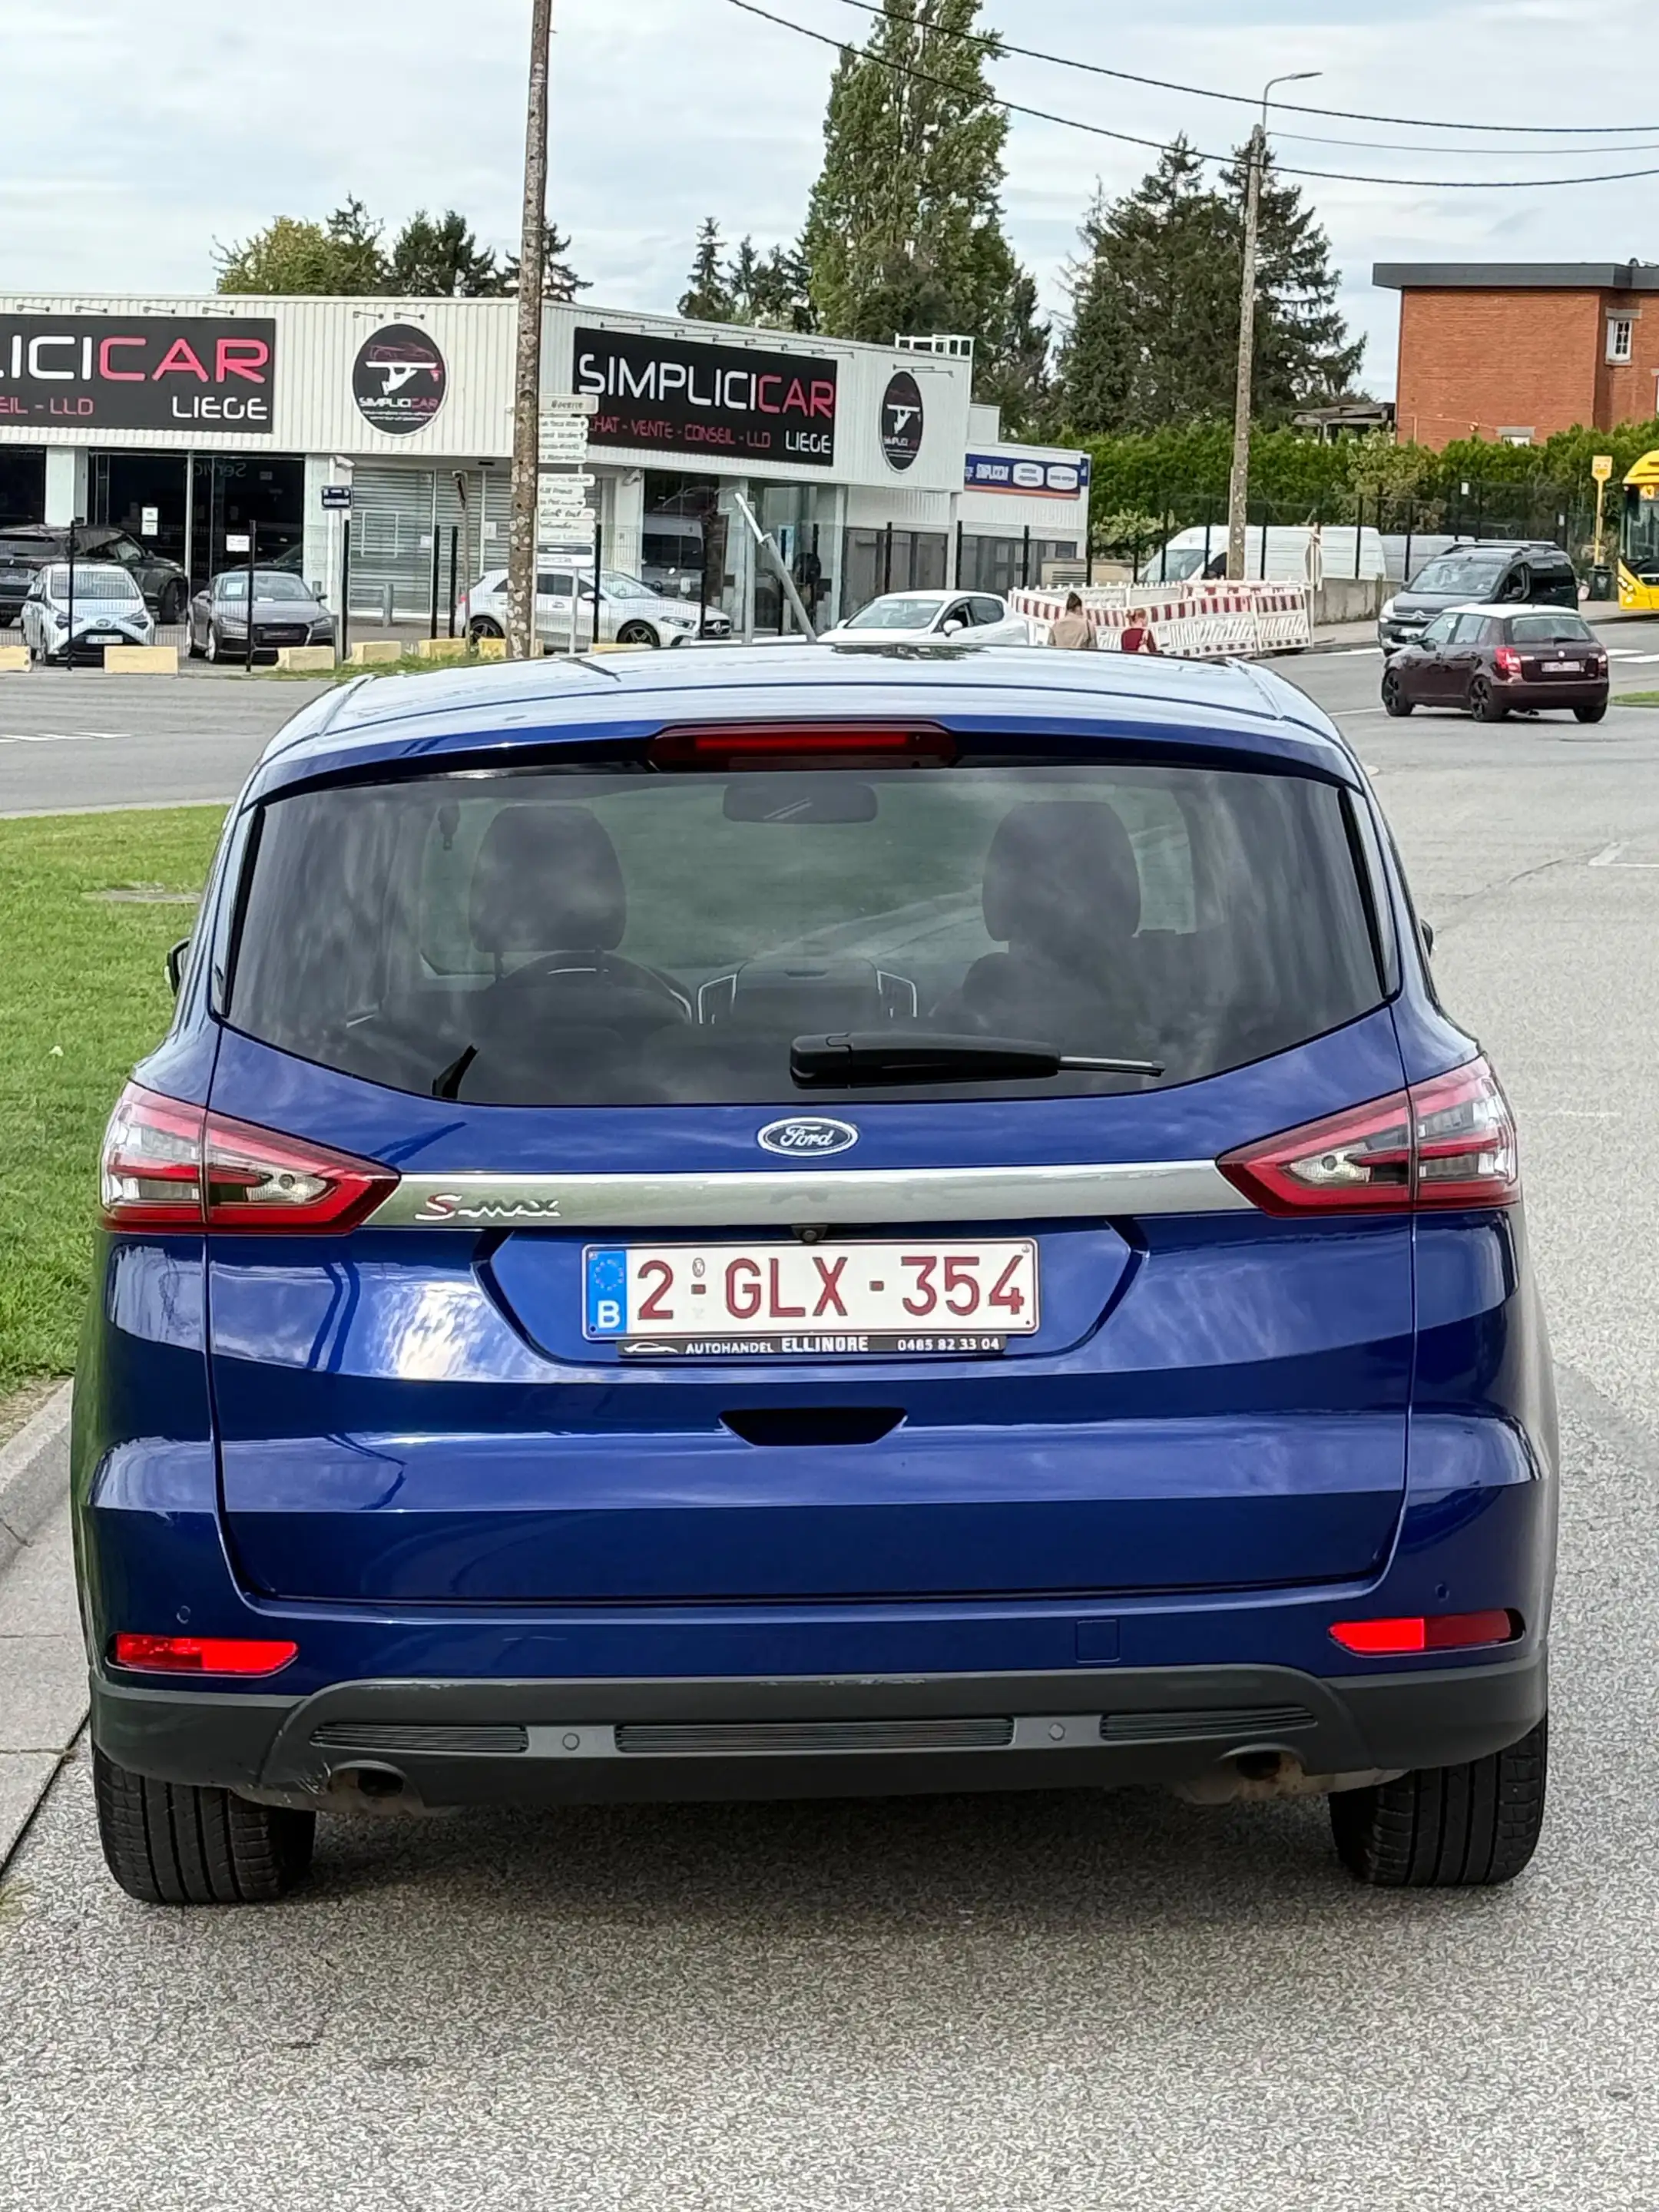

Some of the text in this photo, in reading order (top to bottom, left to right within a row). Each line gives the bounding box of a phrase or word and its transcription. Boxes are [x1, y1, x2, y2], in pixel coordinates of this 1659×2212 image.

[0, 335, 269, 382] ICICAR
[578, 353, 834, 419] SIMPLICICAR
[49, 396, 94, 416] LLD
[171, 396, 268, 420] LIEGE
[631, 419, 674, 439] VENTE
[684, 424, 736, 445] CONSEIL
[747, 430, 771, 449] LLD
[785, 430, 832, 454] LIEGE
[780, 1125, 836, 1147] Ford
[598, 1300, 621, 1328] B
[685, 1336, 869, 1354] AUTOHANDEL ELLINORE
[897, 1337, 999, 1351] 0485 82 33 04
